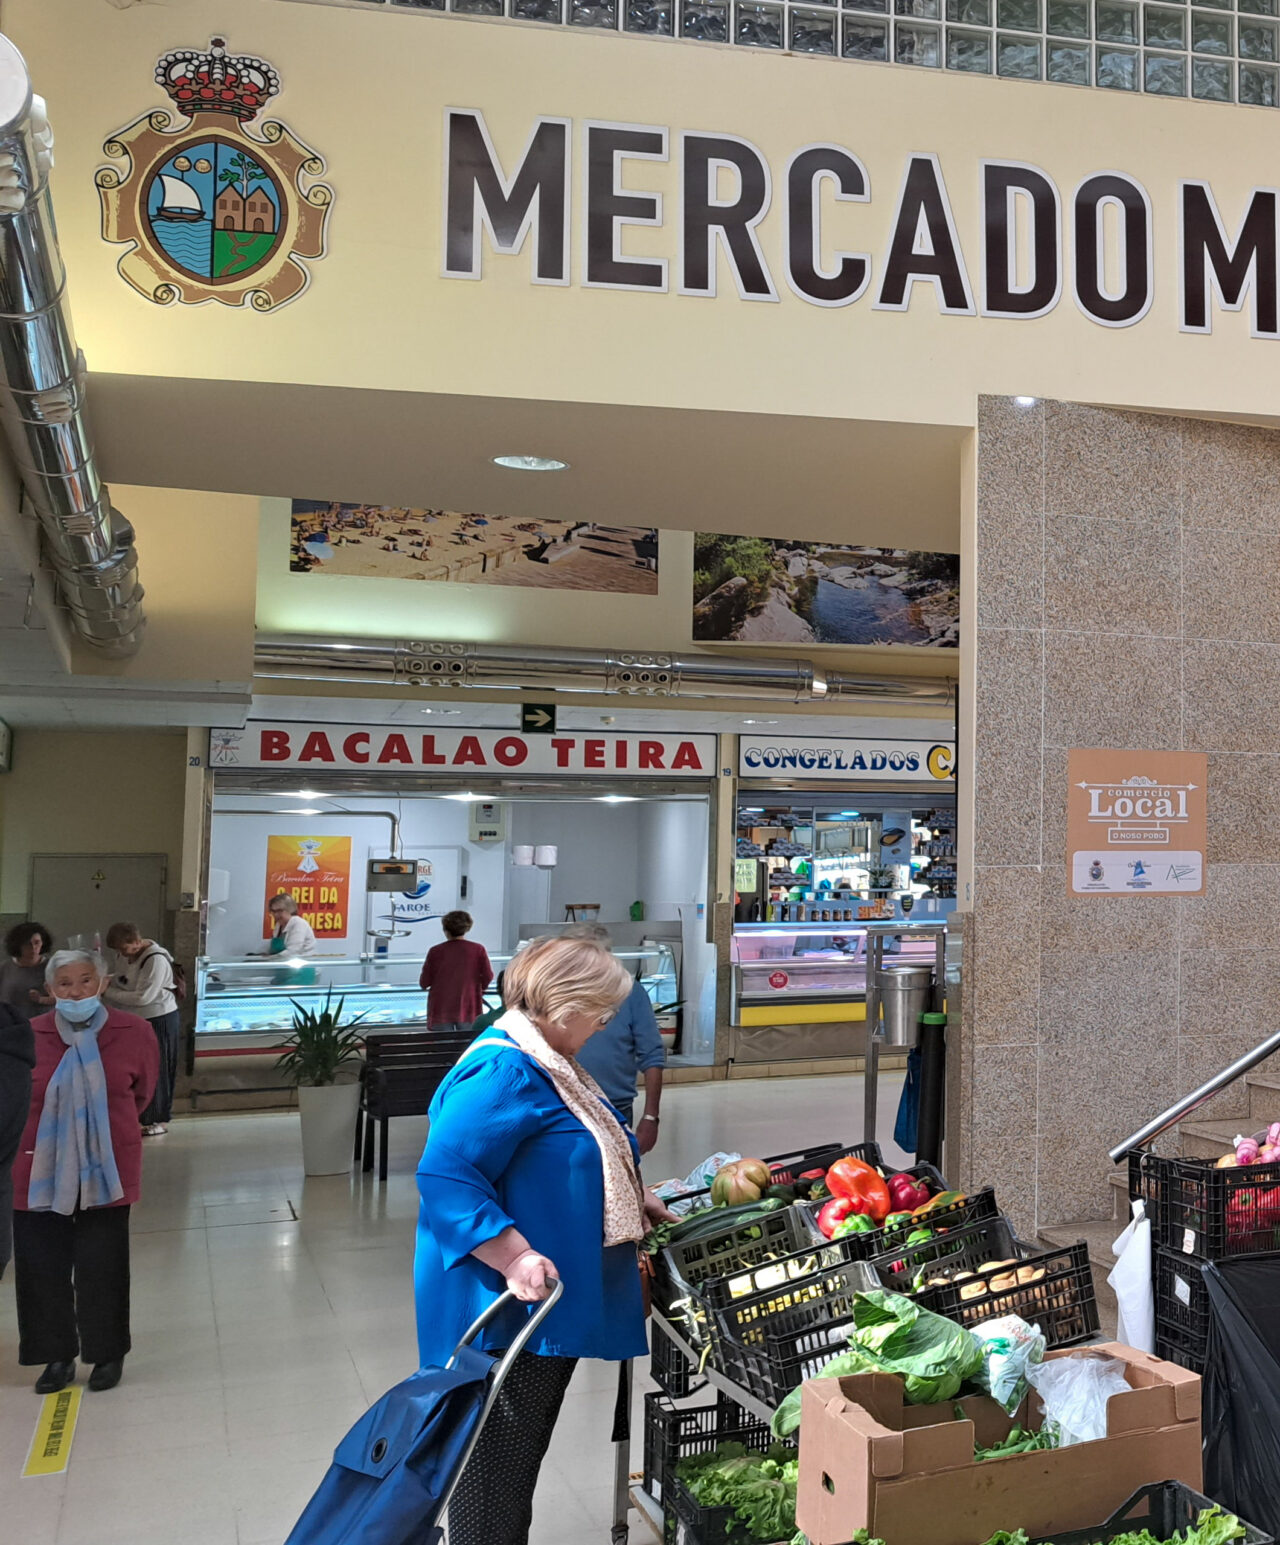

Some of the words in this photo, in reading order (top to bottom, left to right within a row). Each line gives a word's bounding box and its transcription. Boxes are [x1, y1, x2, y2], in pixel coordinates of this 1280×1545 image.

[442, 107, 1153, 327] MERCADO
[259, 730, 529, 767] BACALAO
[551, 738, 703, 770] TEIRA
[189, 756, 200, 767] 20
[744, 747, 920, 771] CONGELADOS
[926, 744, 957, 780] C
[721, 767, 731, 776] 19
[1108, 787, 1170, 797] comercio
[1088, 789, 1188, 818] Local
[417, 865, 432, 874] RGE
[292, 887, 314, 903] REI
[320, 887, 339, 903] DA
[302, 912, 342, 930] MESA
